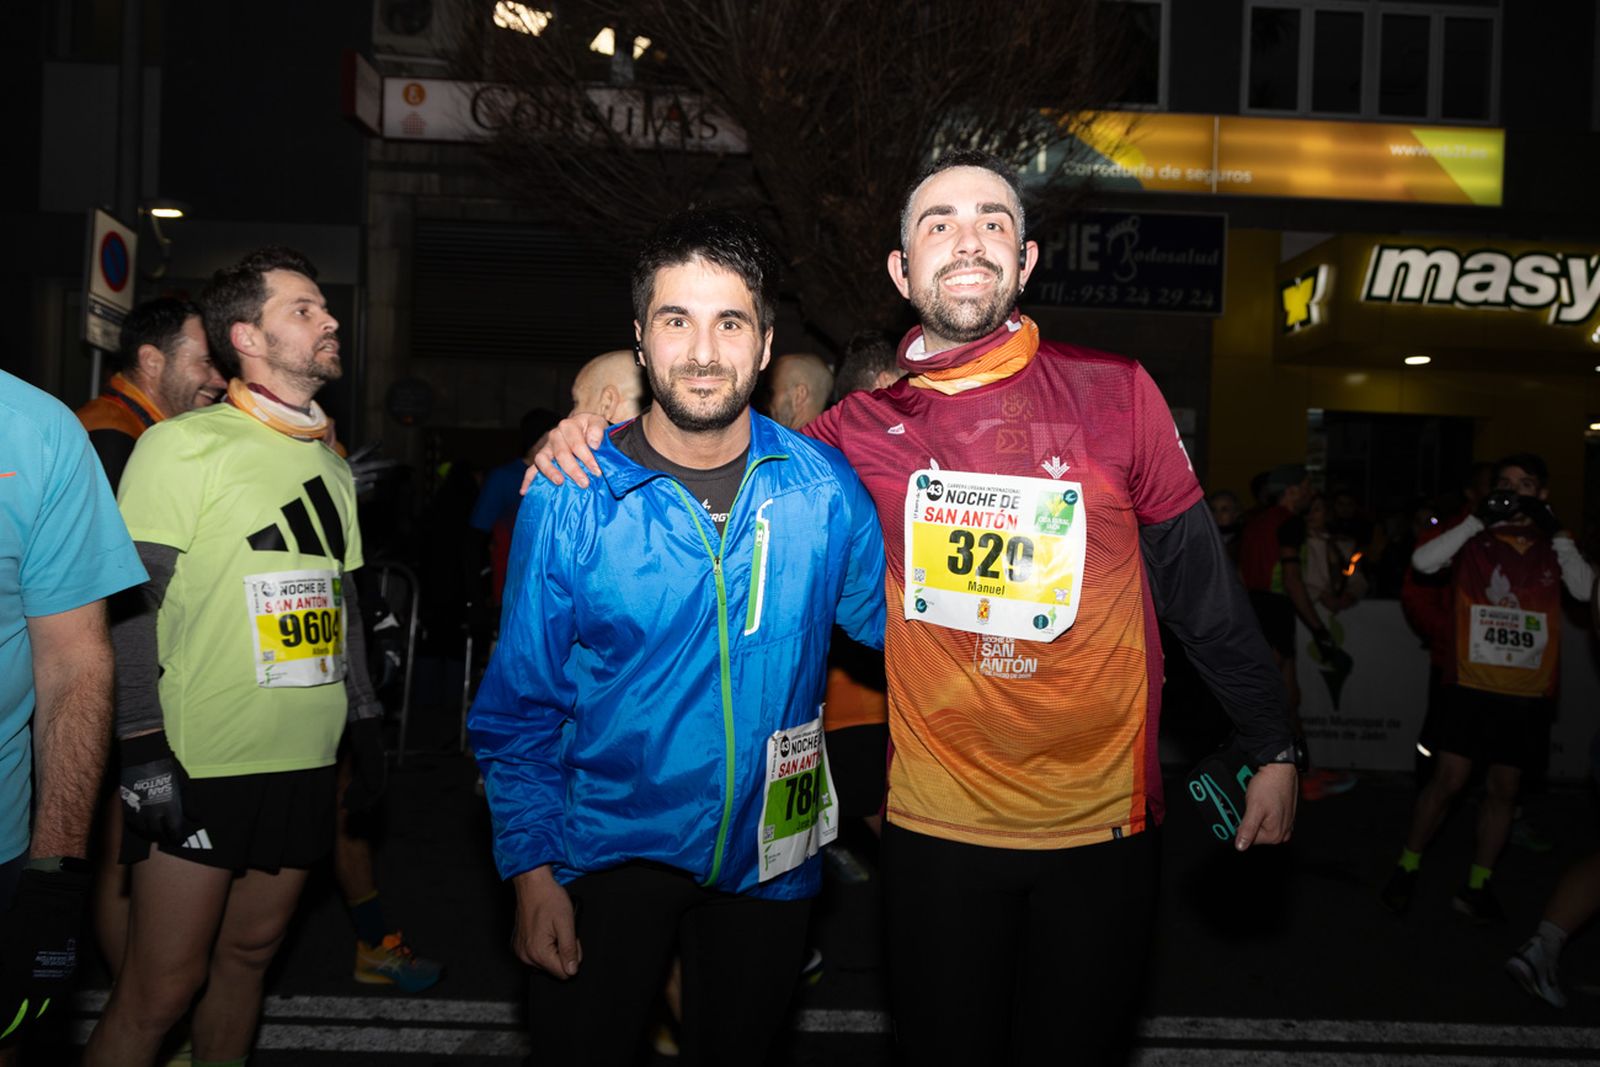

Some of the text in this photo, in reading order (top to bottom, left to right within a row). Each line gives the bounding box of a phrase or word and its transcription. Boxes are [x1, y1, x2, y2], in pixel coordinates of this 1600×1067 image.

[1158, 164, 1181, 181] de
[1043, 222, 1101, 271] PIE
[1360, 245, 1600, 325] masy
[1080, 285, 1118, 304] 953
[1124, 286, 1151, 305] 24
[1156, 288, 1185, 306] 29
[1189, 288, 1216, 308] 24
[927, 483, 942, 496] 43
[945, 489, 1021, 510] NOCHE DE
[709, 513, 729, 523] RG
[923, 506, 1018, 530] SAN ANTÓN
[947, 530, 1035, 582] 329
[279, 583, 315, 597] NOCHE
[317, 582, 327, 593] DE
[967, 580, 1006, 596] Manuel
[1484, 627, 1534, 648] 4839
[980, 642, 1015, 658] SAN
[979, 655, 1038, 674] ANTÓN
[791, 737, 820, 755] NOCHE
[778, 758, 798, 778] SAN
